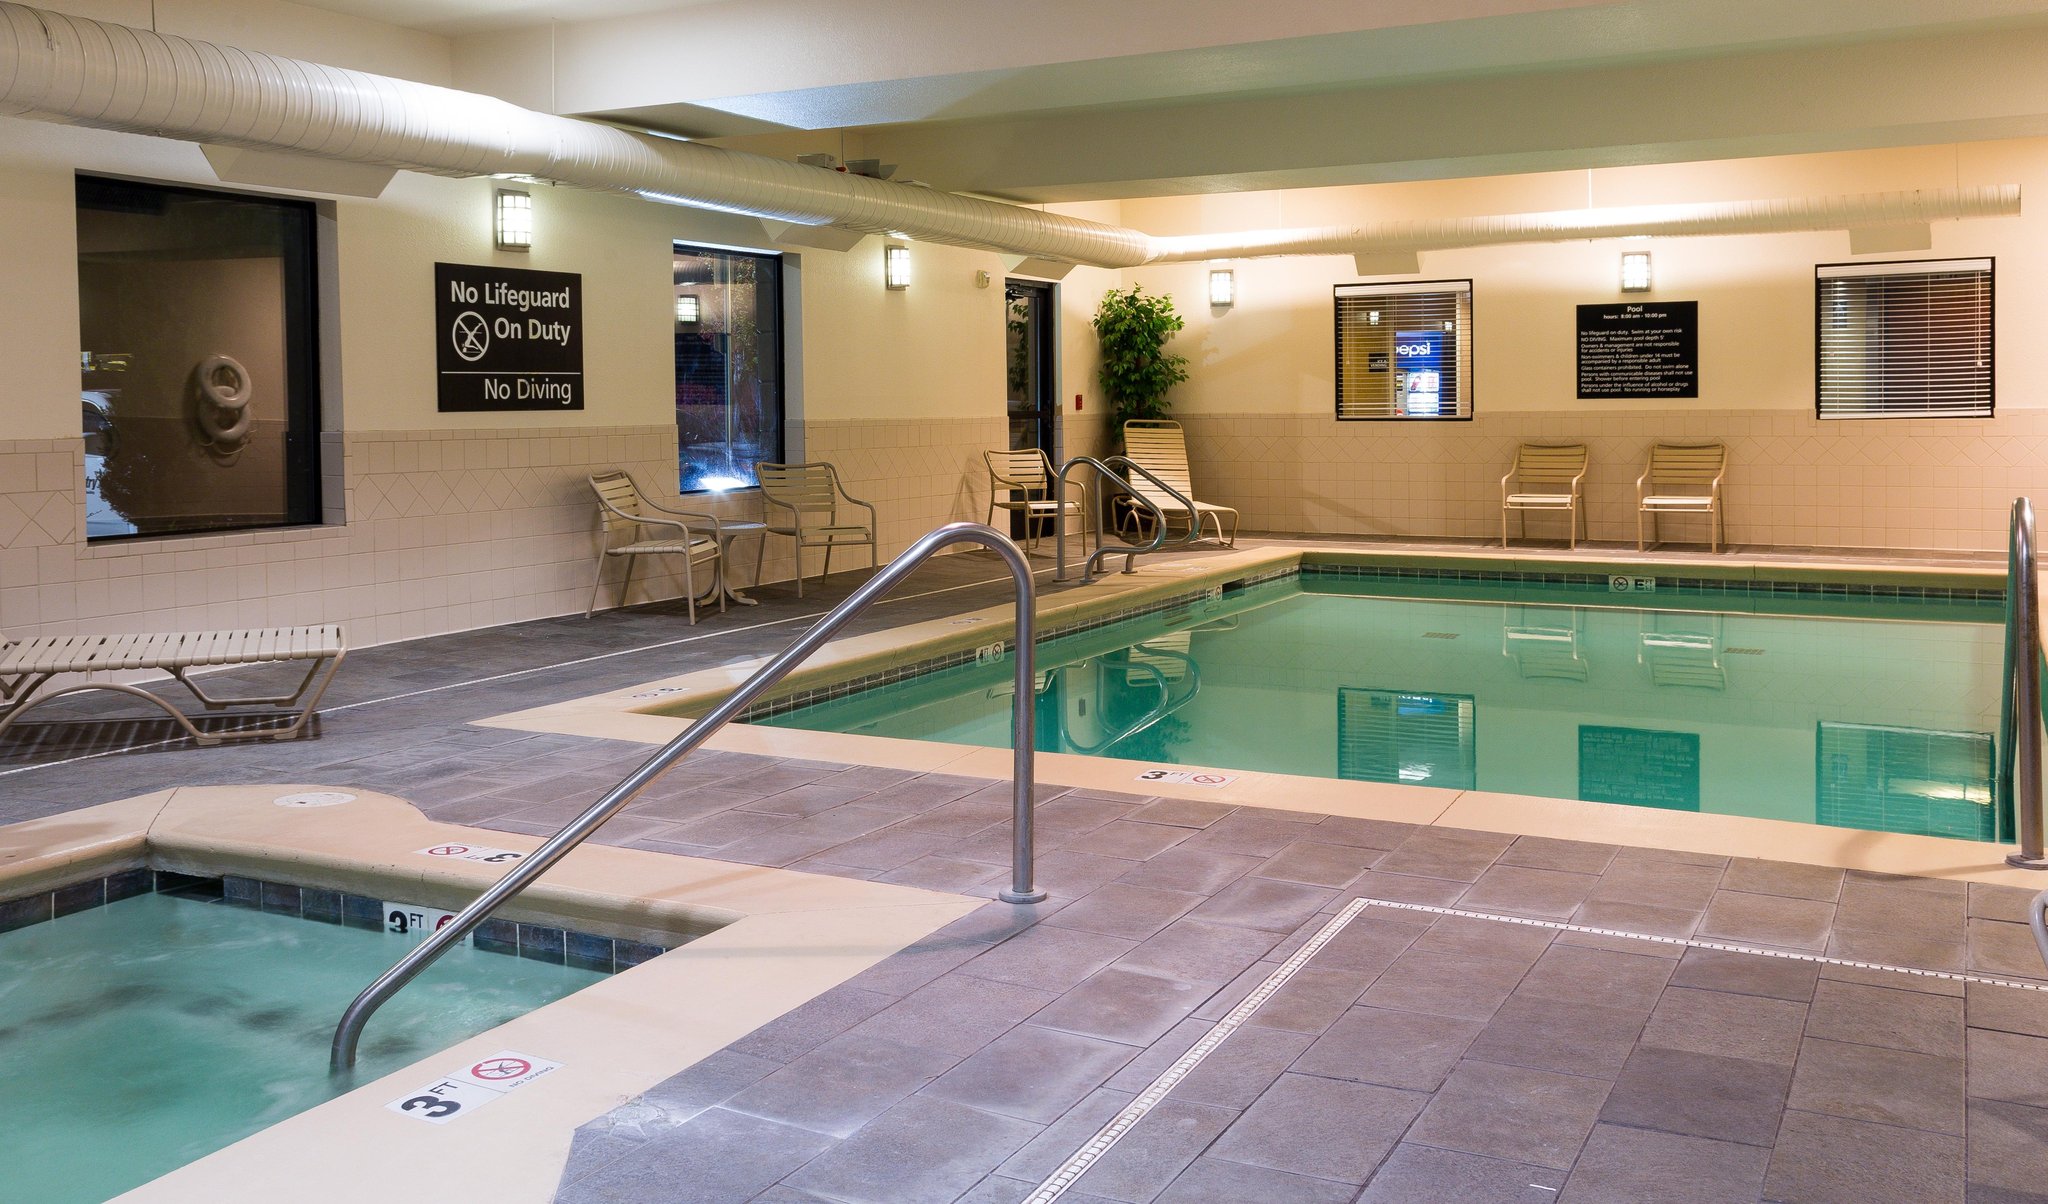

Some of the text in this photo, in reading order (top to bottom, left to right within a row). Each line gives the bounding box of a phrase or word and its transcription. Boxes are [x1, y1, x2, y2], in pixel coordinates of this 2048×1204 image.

[451, 281, 570, 312] No Lifeguard
[494, 317, 571, 346] On Duty
[485, 378, 572, 404] No Diving
[1141, 770, 1168, 780] 3
[484, 853, 522, 862] 3
[389, 910, 424, 934] 3 FT
[401, 1081, 462, 1118] 3 FT
